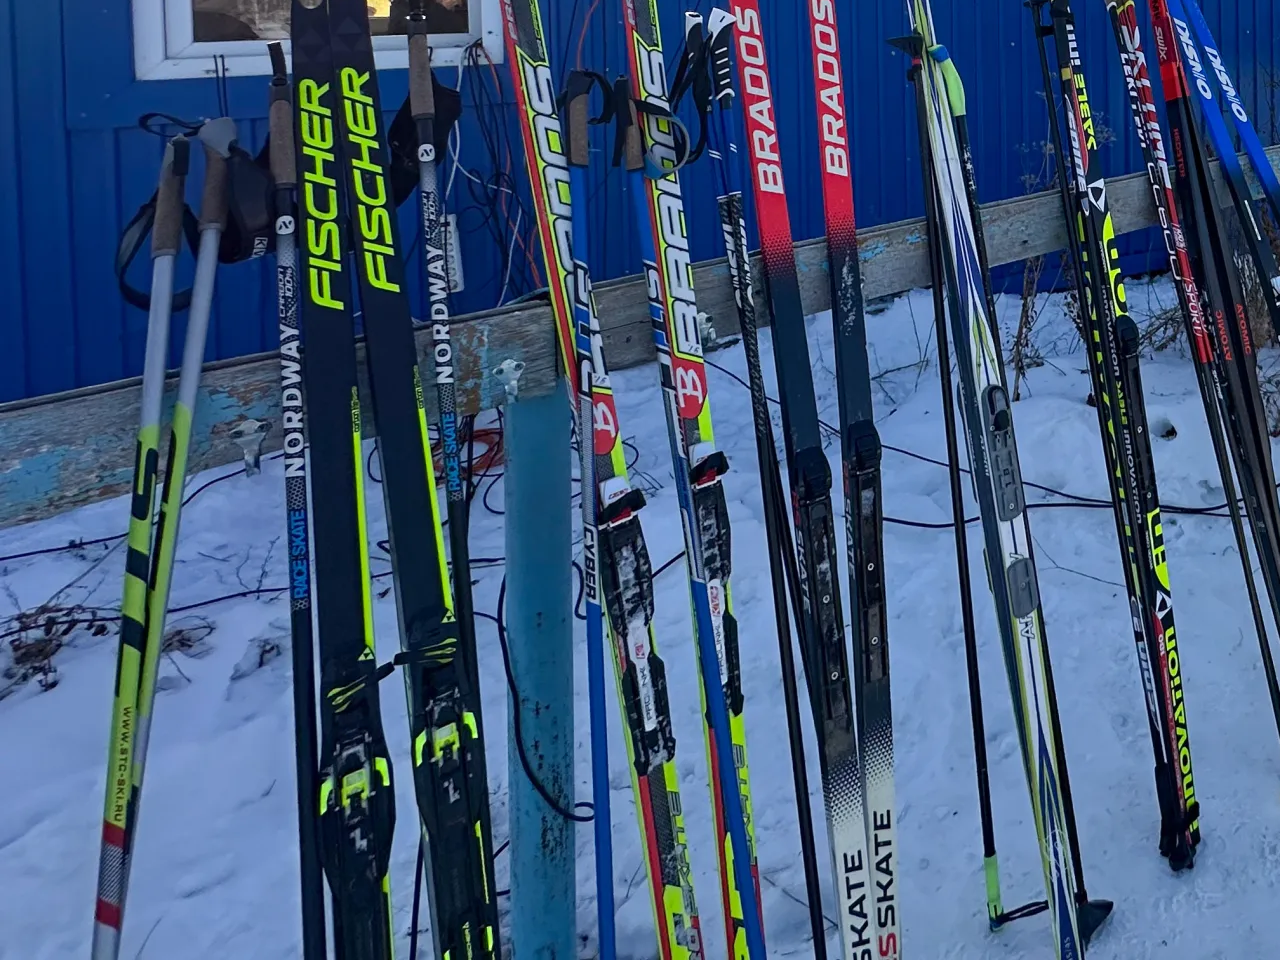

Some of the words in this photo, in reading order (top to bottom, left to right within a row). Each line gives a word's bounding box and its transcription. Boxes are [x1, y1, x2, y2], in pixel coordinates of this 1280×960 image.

[734, 5, 785, 195] BRADOS
[1073, 73, 1097, 151] SABLE
[300, 78, 344, 311] FISCHER
[340, 66, 400, 293] FISCHER
[285, 268, 293, 298] 100%
[425, 243, 455, 385] NORDWAY
[1215, 310, 1232, 361] ATOMIC
[1236, 303, 1252, 356] ATOMIC
[279, 323, 307, 477] NORDWAY
[442, 413, 458, 453] SKATE
[445, 453, 461, 491] RACE
[290, 510, 306, 557] SKATE
[584, 526, 597, 601] CYBER
[797, 530, 812, 614] SKATE
[846, 499, 857, 581] SKATE
[293, 559, 309, 599] RACE
[113, 706, 132, 822] WWW.STC-SKI.RU
[873, 809, 896, 929] SKATE
